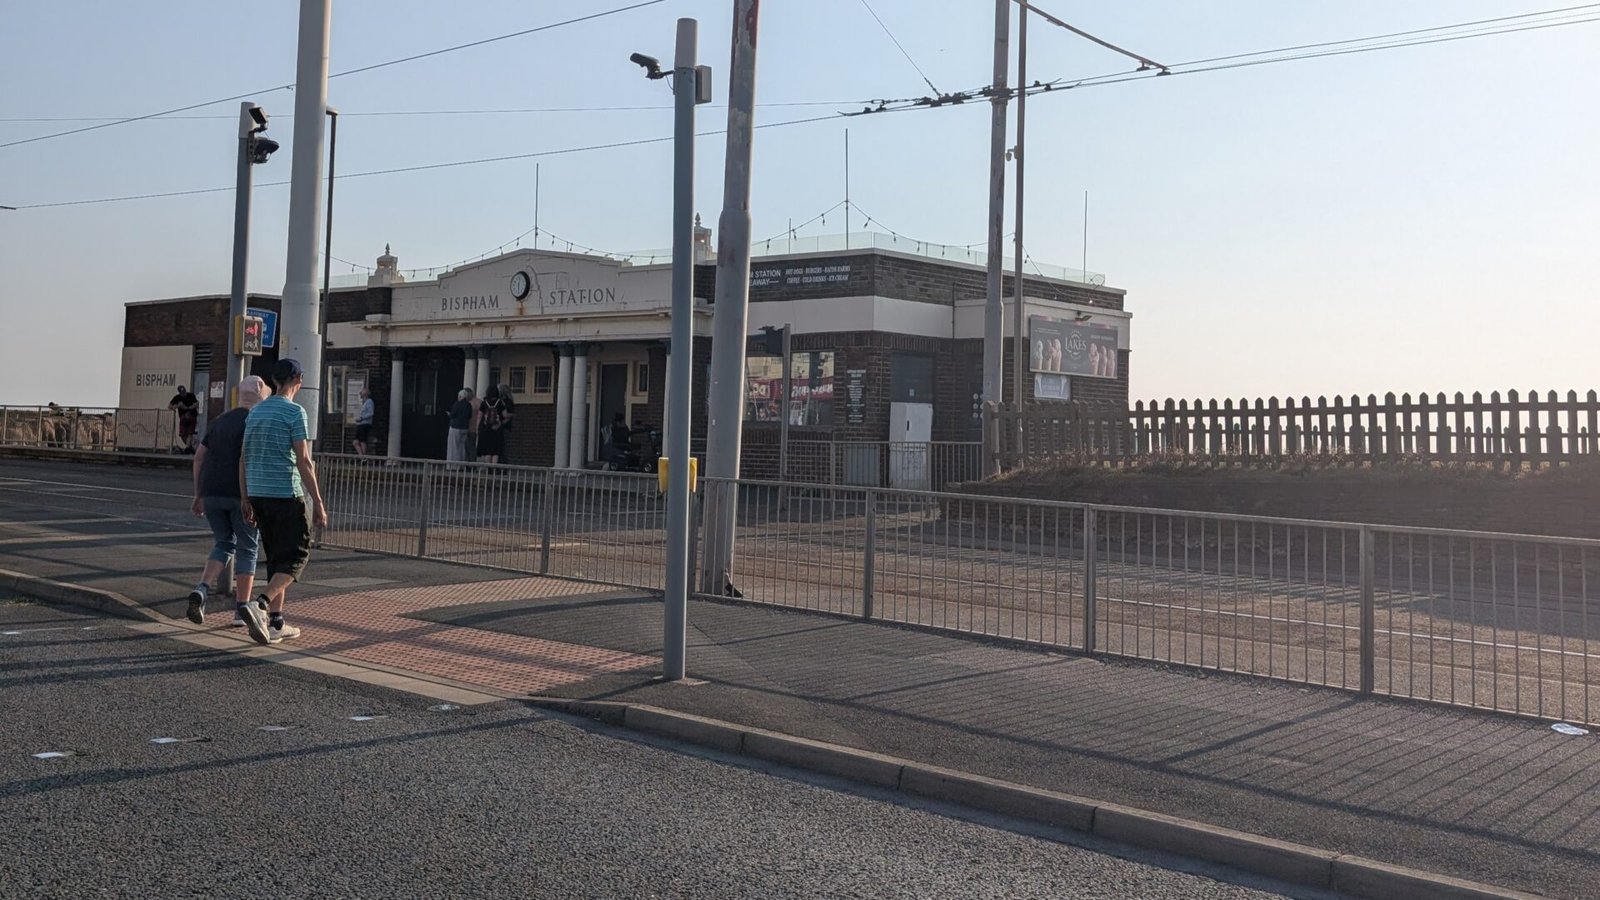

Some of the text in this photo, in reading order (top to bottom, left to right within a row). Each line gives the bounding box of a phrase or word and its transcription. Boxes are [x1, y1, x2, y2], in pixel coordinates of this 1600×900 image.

[755, 269, 781, 278] STATION
[441, 287, 616, 311] BISPHAM STATION
[136, 373, 176, 387] BISPHAM
